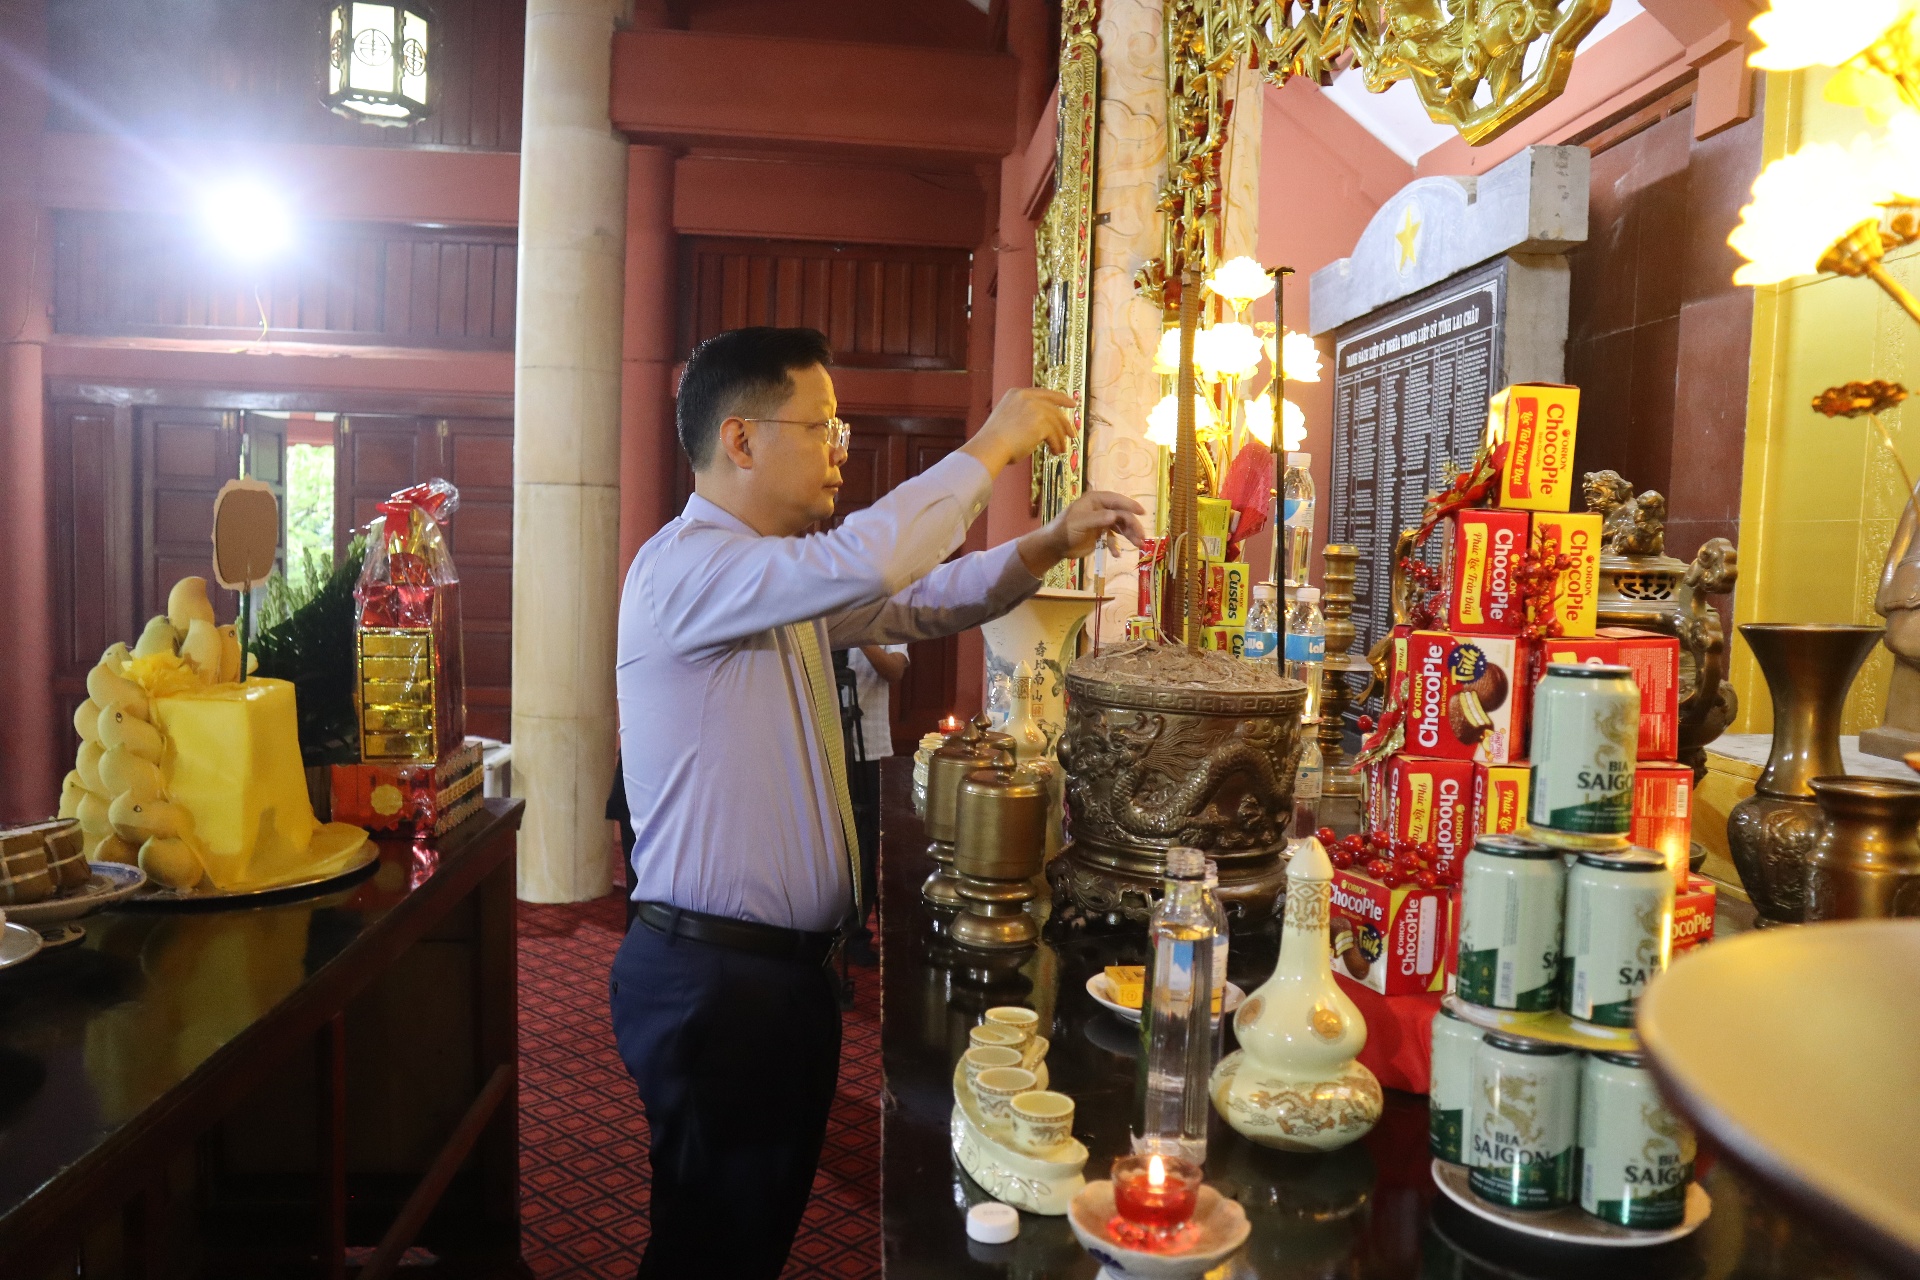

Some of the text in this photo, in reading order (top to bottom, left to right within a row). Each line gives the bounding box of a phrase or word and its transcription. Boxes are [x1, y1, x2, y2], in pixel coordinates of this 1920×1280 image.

[1401, 330, 1418, 349] TRANG
[1417, 323, 1430, 344] LIỆT
[1438, 313, 1452, 336] TỈNH
[1452, 313, 1463, 331] LAI
[1463, 304, 1480, 327] CHÂU
[1520, 411, 1534, 426] Lộc
[1516, 444, 1529, 467] Phát
[1540, 403, 1565, 495] ChocoPie
[1559, 439, 1570, 470] ORION
[1511, 468, 1525, 485] Đạt
[1462, 532, 1483, 616] Phúc Lộc Tràn Đầy
[1490, 528, 1514, 620] ChocoPie
[1566, 529, 1589, 621] ChocoPie
[1585, 566, 1594, 596] ORION
[1228, 569, 1242, 620] Custas
[1451, 647, 1480, 686] Tình
[1414, 673, 1423, 708] ORION
[1418, 645, 1443, 748] ChocoPie
[1609, 761, 1628, 772] BIA
[1417, 782, 1428, 806] Phúc
[1412, 808, 1426, 823] Lộc
[1498, 789, 1515, 831] Phúc Lộc
[1455, 815, 1464, 846] ORION
[1398, 920, 1407, 948] ORION
[1401, 898, 1419, 976] ChocoPie
[1672, 911, 1713, 940] ocoPie
[1474, 1134, 1552, 1166] SAIGON
[1495, 1131, 1520, 1146] BIA
